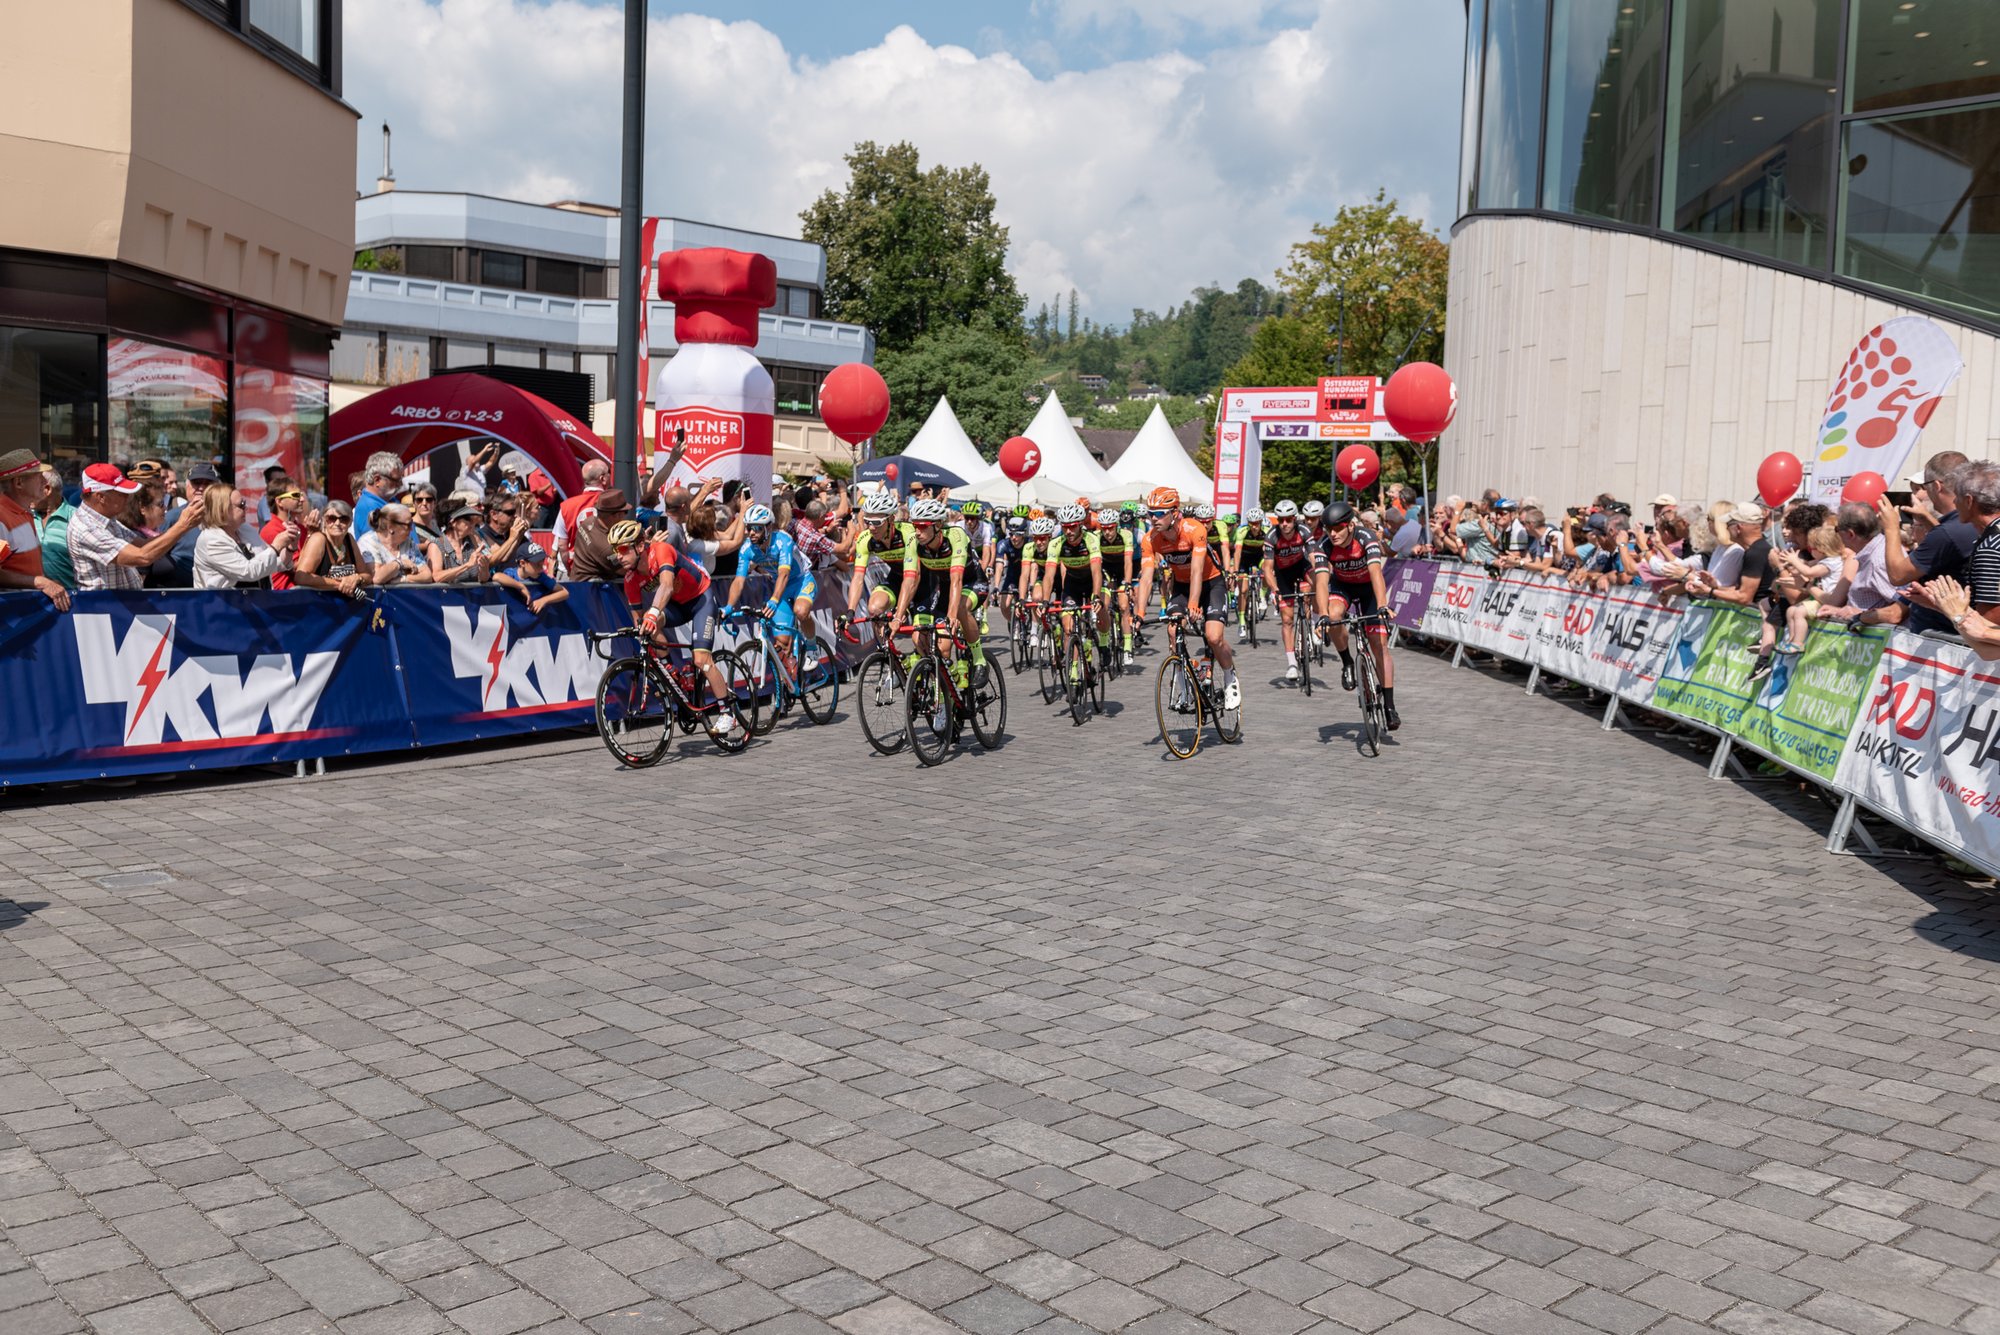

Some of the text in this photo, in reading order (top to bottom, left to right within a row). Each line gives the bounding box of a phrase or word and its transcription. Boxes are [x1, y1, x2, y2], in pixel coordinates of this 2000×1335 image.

[1324, 379, 1370, 387] ÖSTERREICH
[391, 405, 504, 422] ARBÖ 1-2-3
[663, 420, 739, 434] MAUTNER
[671, 434, 727, 445] MRKHOF
[689, 447, 706, 455] 1841
[1822, 478, 1840, 486] UCI
[1445, 583, 1475, 609] RAD
[1563, 604, 1594, 636] RAD
[655, 657, 690, 703] MERIDA
[1866, 674, 1936, 741] RAD
